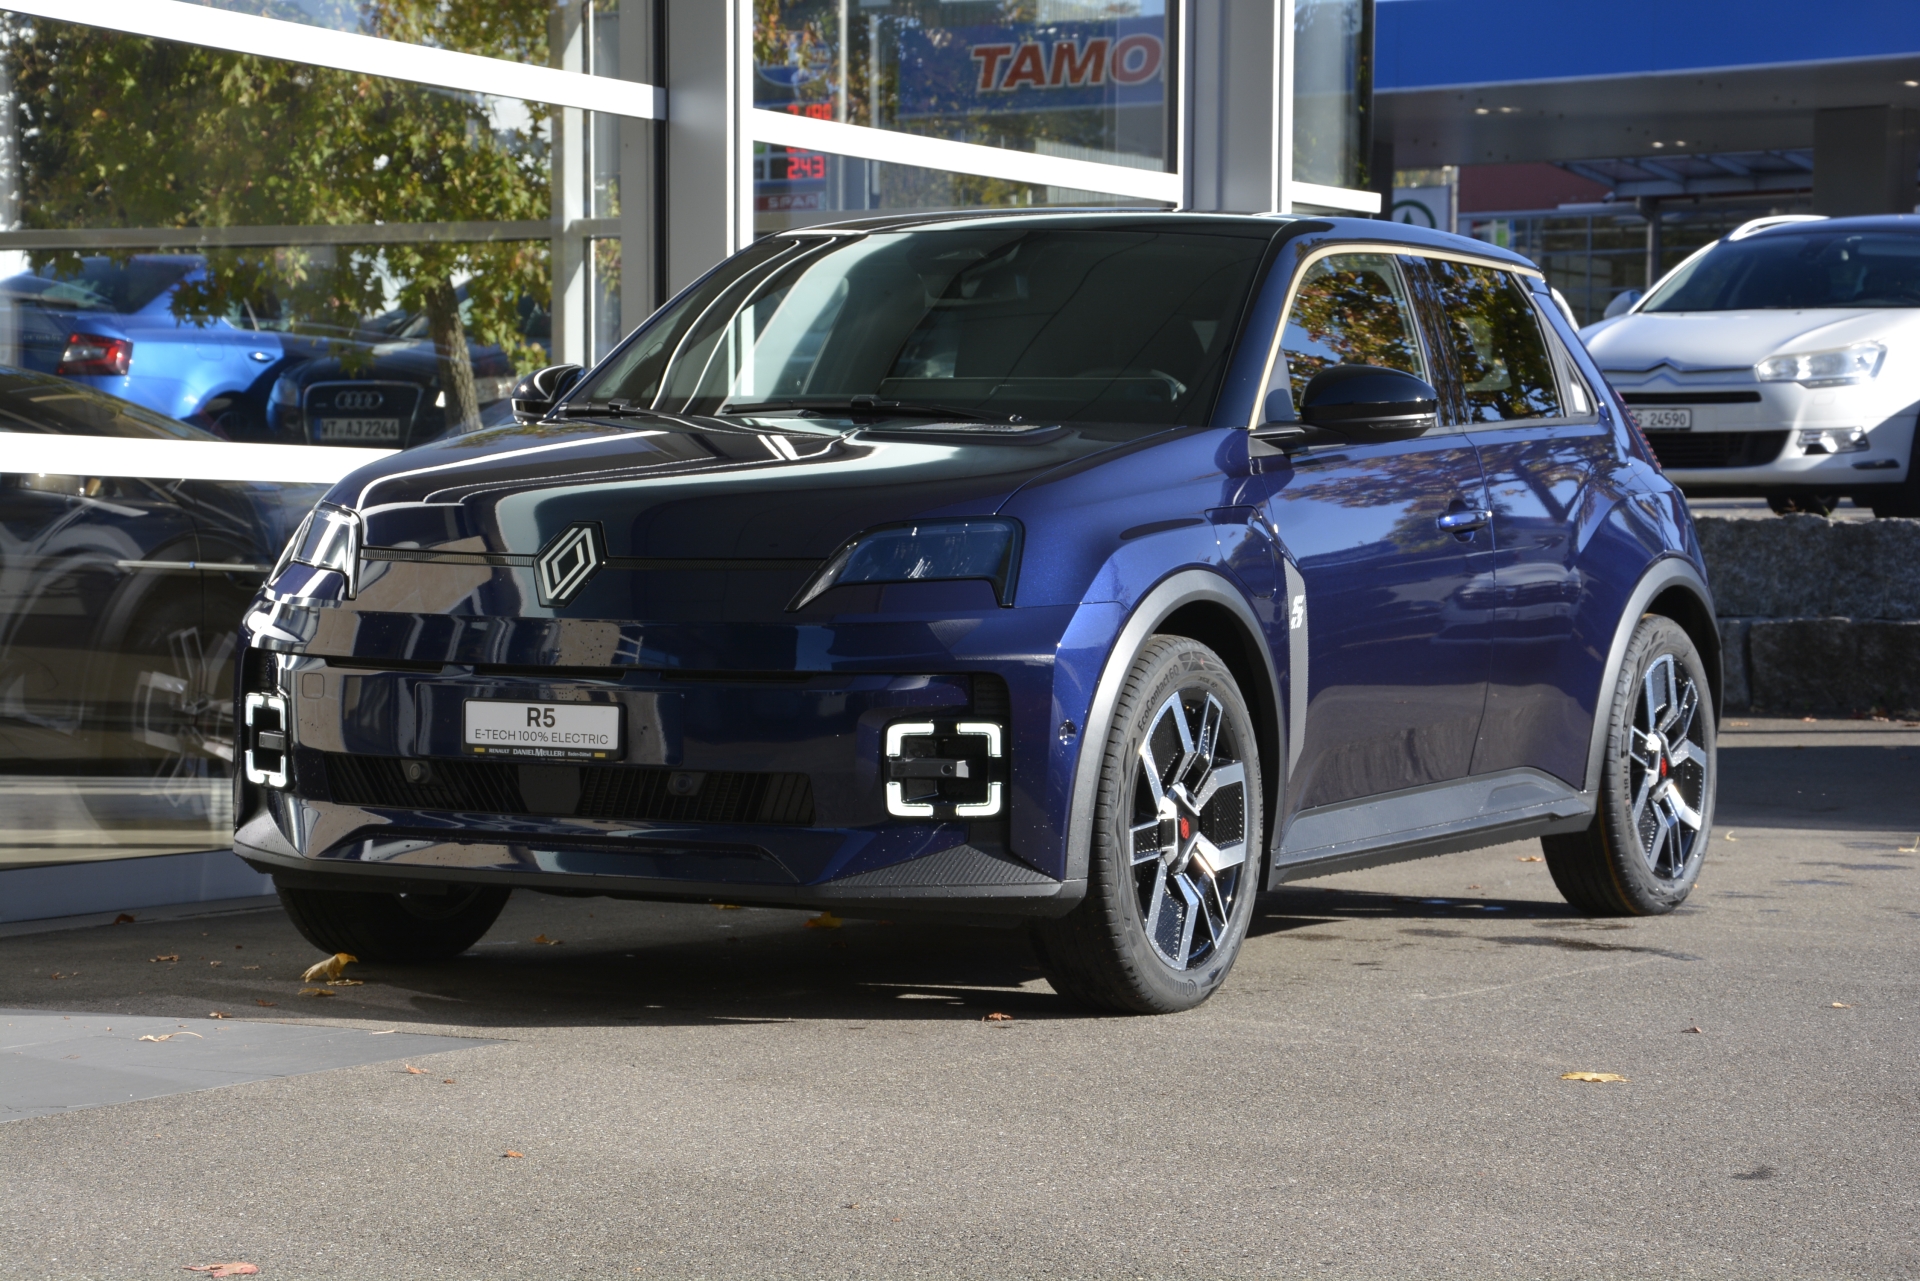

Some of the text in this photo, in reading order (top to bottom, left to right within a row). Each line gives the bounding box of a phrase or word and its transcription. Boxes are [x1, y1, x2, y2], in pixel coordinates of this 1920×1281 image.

[973, 33, 1165, 92] TAMO
[768, 195, 818, 208] SPAR
[1650, 413, 1686, 426] 24590
[365, 421, 397, 436] 2244
[1137, 672, 1170, 732] EcoContact
[526, 707, 556, 728] R5
[474, 729, 609, 745] E-TECH 100% ELECTRIC
